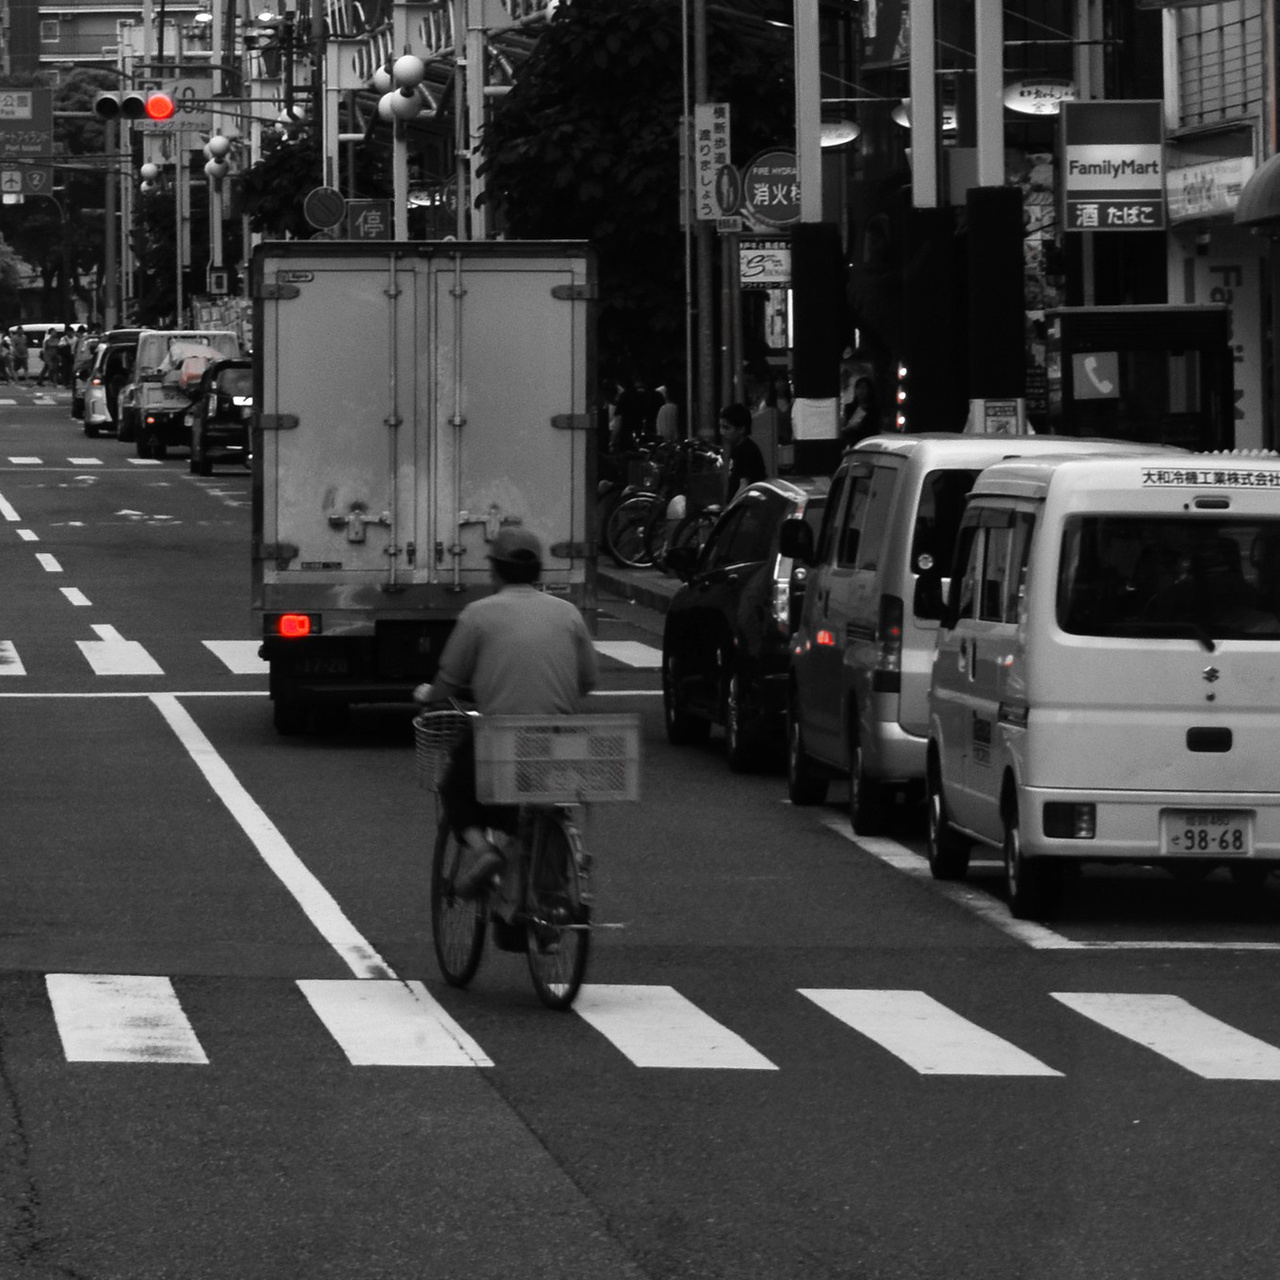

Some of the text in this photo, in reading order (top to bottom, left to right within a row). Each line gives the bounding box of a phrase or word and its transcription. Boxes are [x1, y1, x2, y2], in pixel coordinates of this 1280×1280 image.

[1069, 159, 1160, 179] FamilyMart
[354, 209, 384, 237] 停
[1076, 204, 1155, 226] 酒 たばこ
[1183, 829, 1243, 851] 98-68
